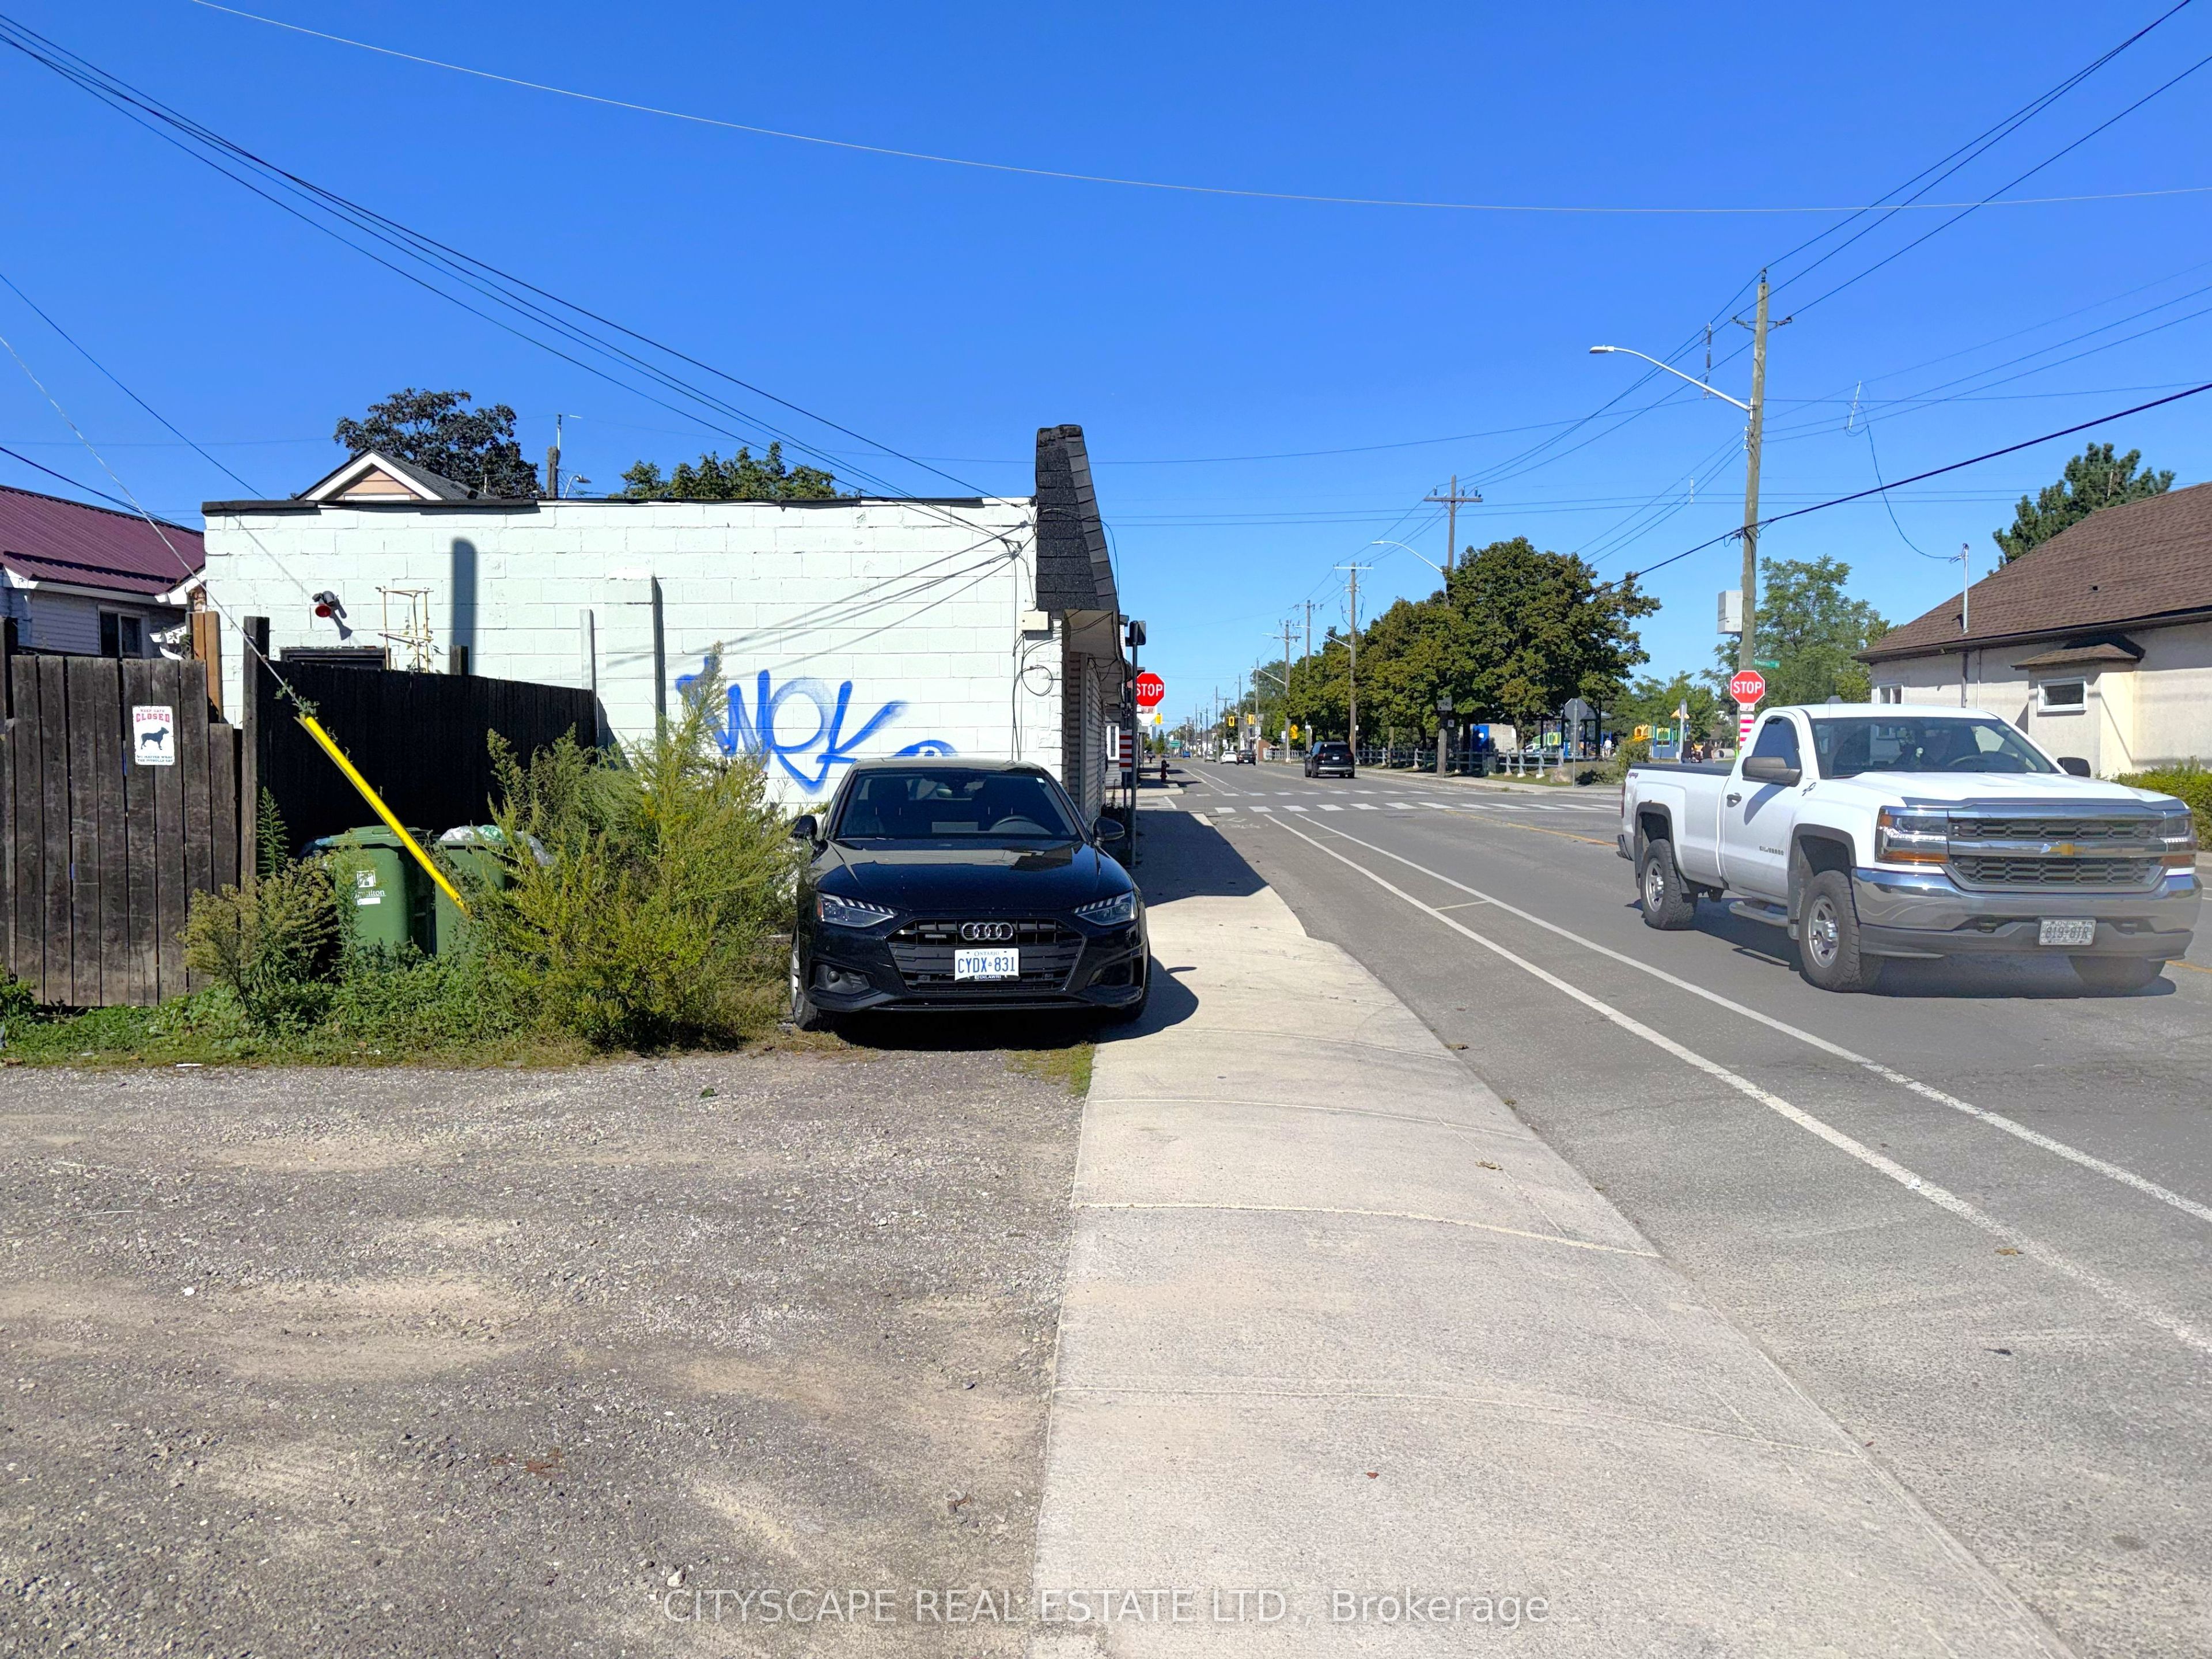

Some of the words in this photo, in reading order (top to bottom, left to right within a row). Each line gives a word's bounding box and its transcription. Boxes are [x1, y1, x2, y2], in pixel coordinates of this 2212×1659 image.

[1733, 681, 1762, 694] STOP
[136, 713, 170, 723] CLOSED
[958, 957, 987, 974] CYDX
[994, 956, 1015, 972] 831
